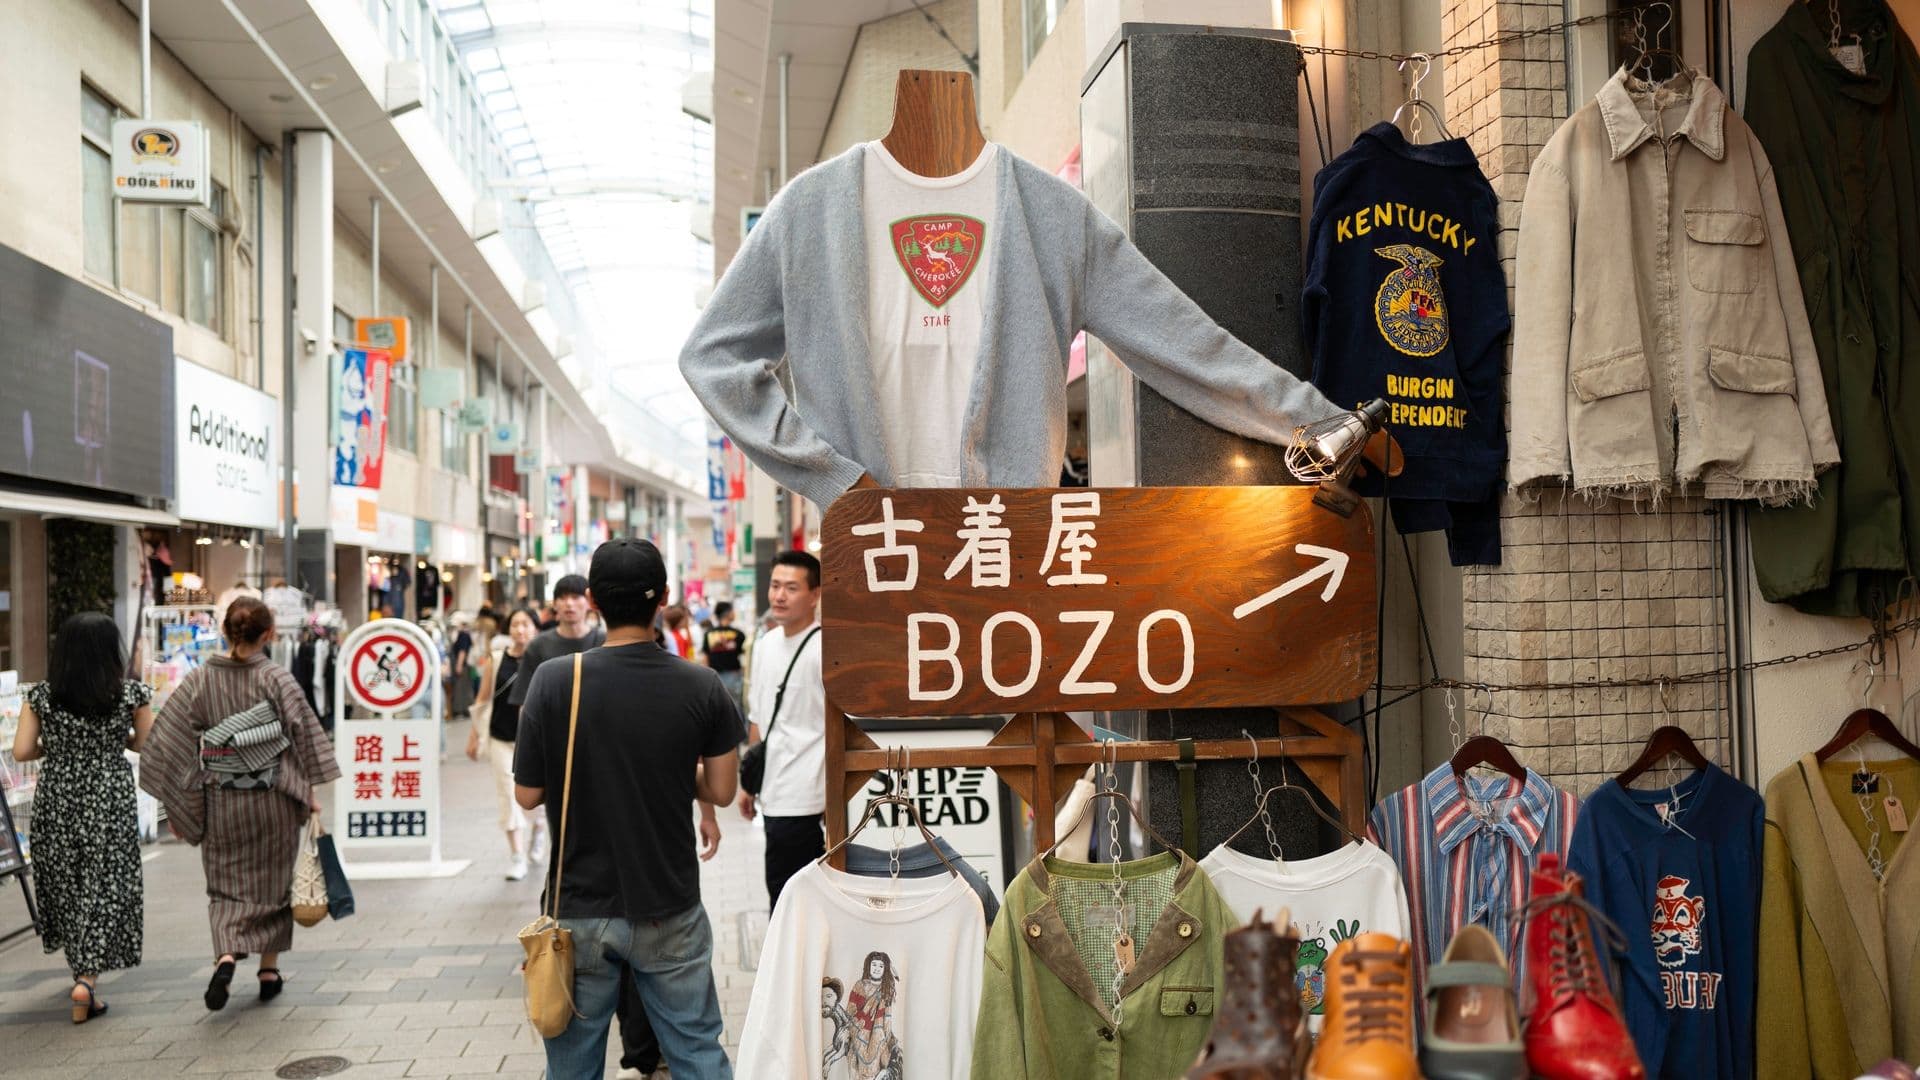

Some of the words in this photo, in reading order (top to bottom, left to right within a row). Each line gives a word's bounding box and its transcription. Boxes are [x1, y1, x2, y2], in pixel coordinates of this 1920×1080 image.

[923, 222, 953, 232] CAMP
[1337, 202, 1476, 256] KENTUCKY
[914, 266, 962, 283] CHEROKEE
[930, 284, 948, 296] BSA
[1411, 290, 1436, 313] FFA
[1397, 324, 1440, 342] EDUCATION
[1386, 374, 1454, 399] BURGIN
[189, 404, 270, 475] Additional
[850, 492, 1108, 592] 古着屋
[906, 608, 1195, 702] BOZO
[355, 735, 421, 763] 路上
[354, 771, 421, 800] 禁煙
[867, 767, 958, 796] STEP
[865, 796, 990, 828] AHEAD
[1666, 888, 1674, 898] A
